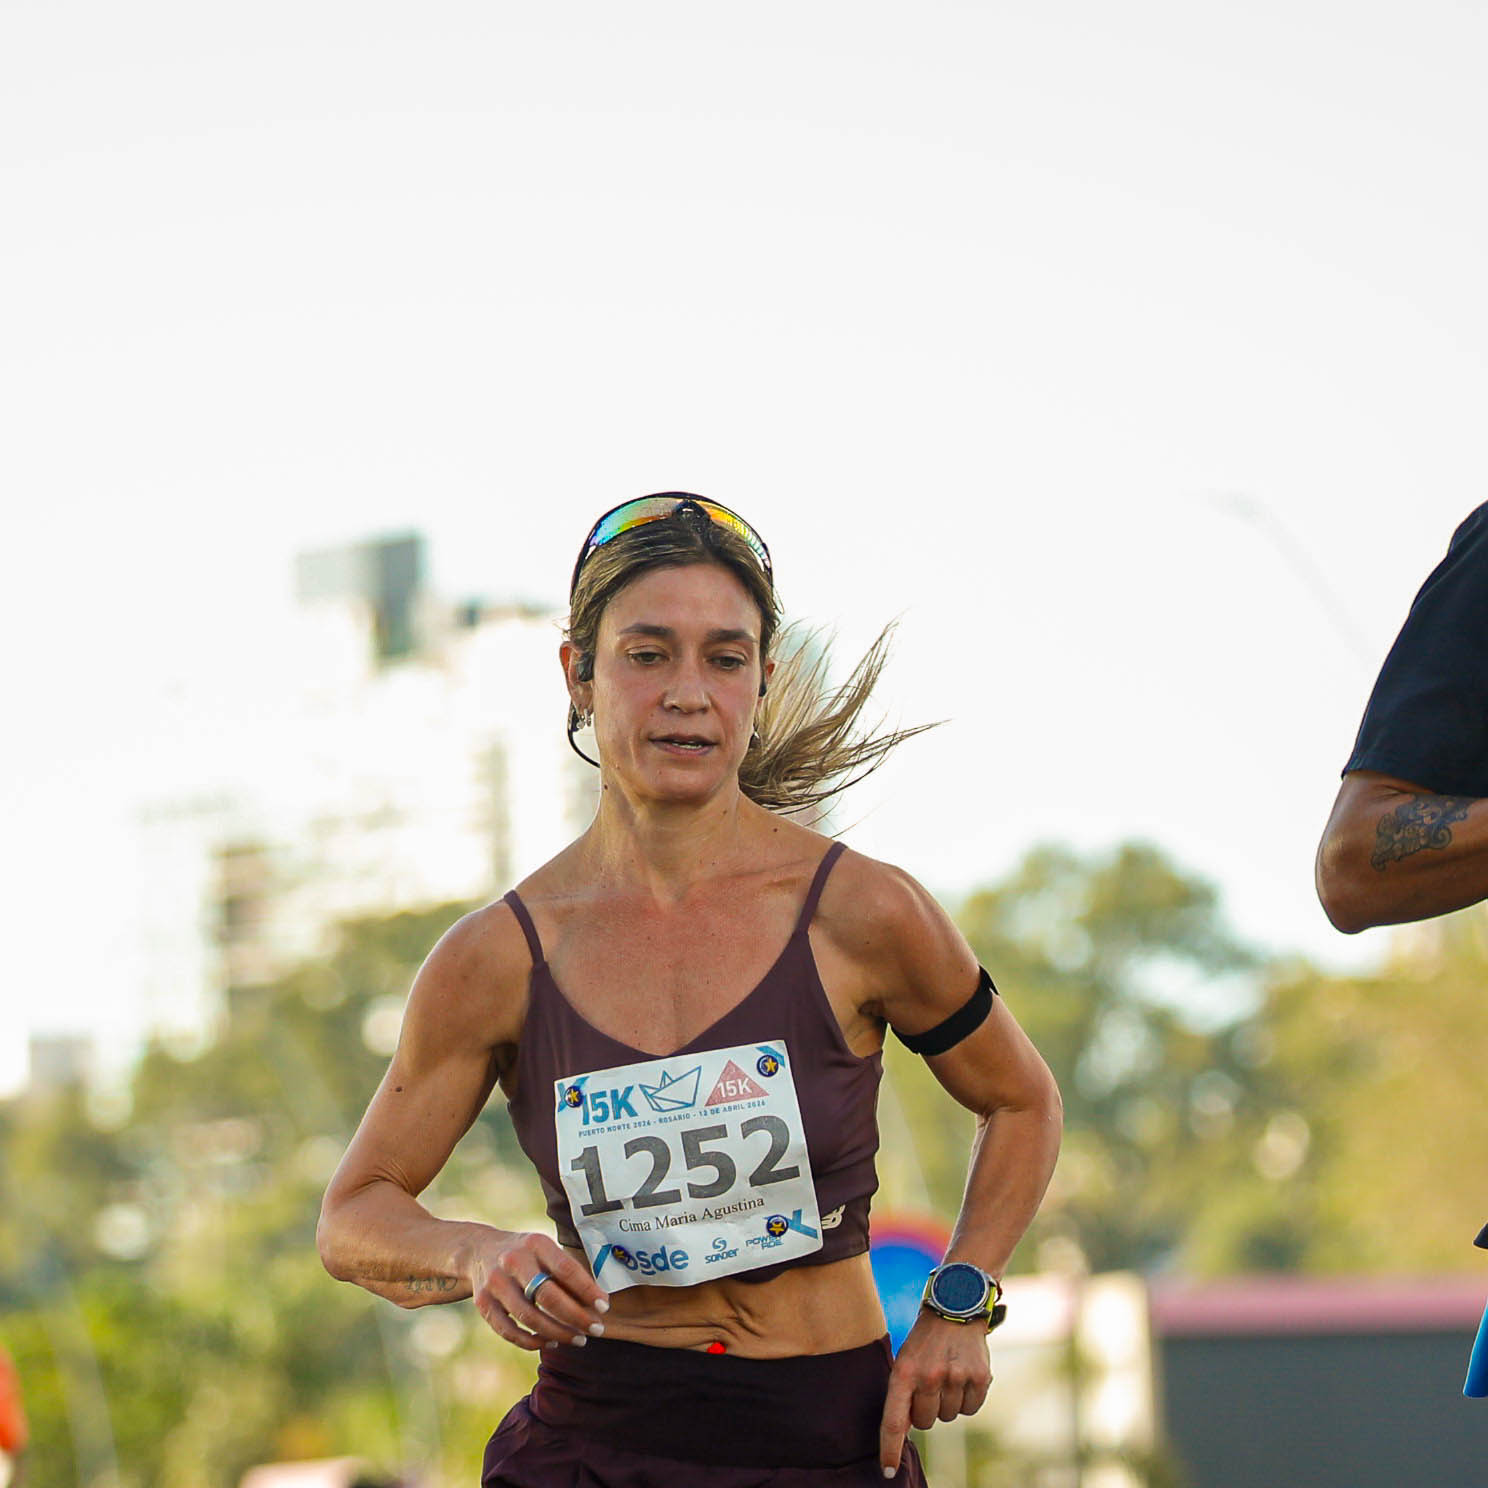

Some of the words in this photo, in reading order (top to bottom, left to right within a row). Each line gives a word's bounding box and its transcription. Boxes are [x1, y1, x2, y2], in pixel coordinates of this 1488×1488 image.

[717, 1077, 753, 1098] 15K
[579, 1127, 605, 1138] PUERTO
[607, 1123, 631, 1133] NORTE
[658, 1113, 691, 1123] ROSARIO
[710, 1107, 720, 1115] DE
[722, 1104, 745, 1112] ABRIL
[582, 1085, 639, 1126] 15K
[570, 1115, 801, 1217] 1252
[619, 1218, 652, 1233] Cima
[655, 1211, 697, 1230] Maria
[701, 1197, 765, 1220] Agustina
[622, 1245, 689, 1275] osde
